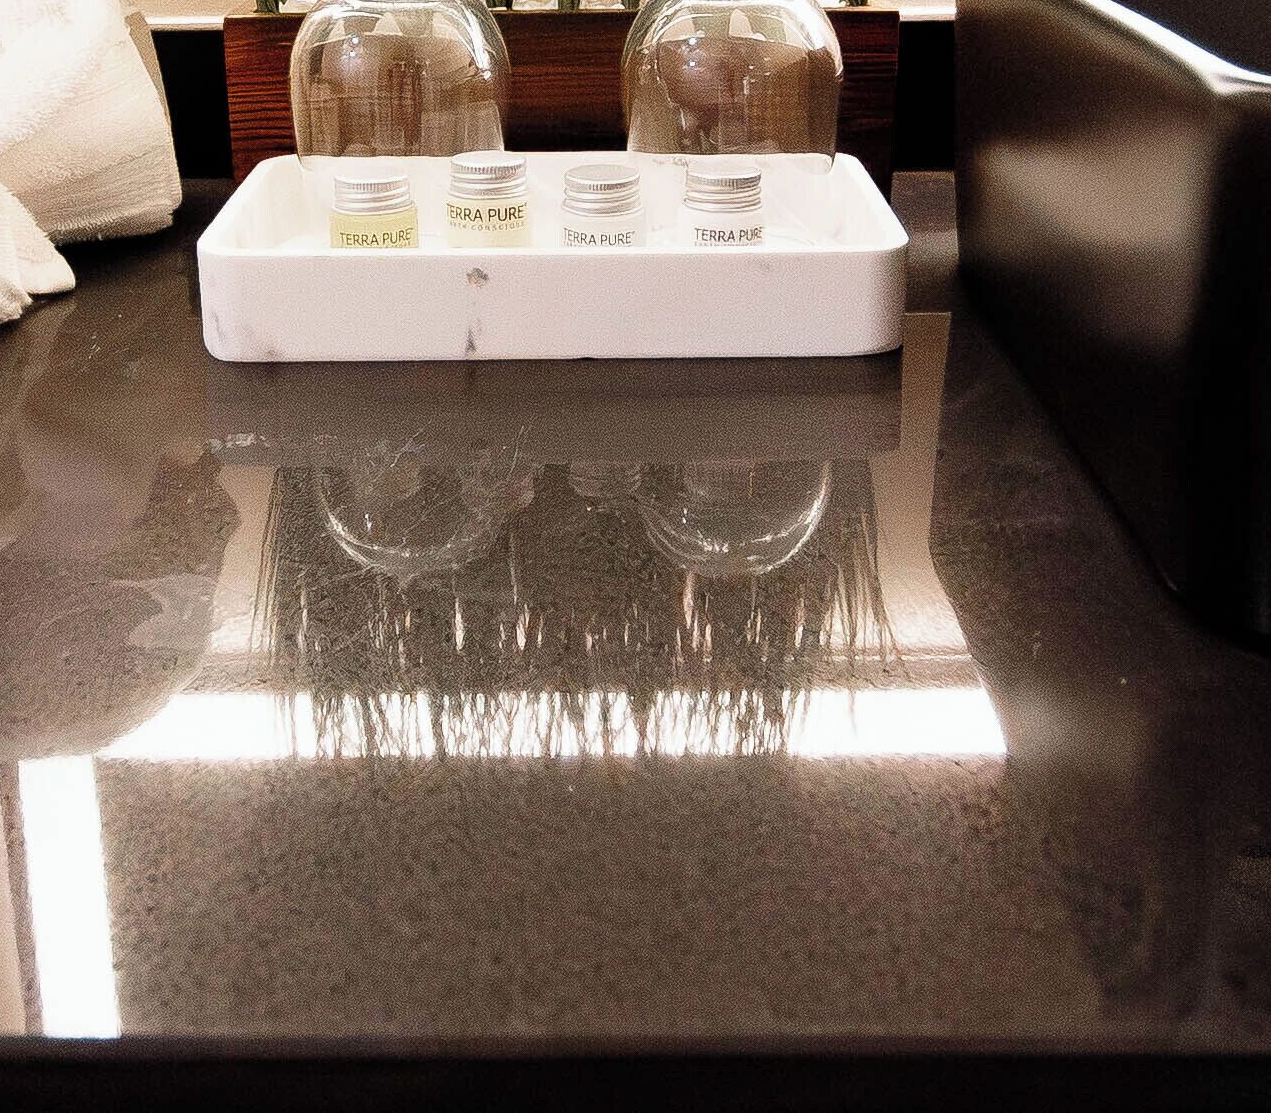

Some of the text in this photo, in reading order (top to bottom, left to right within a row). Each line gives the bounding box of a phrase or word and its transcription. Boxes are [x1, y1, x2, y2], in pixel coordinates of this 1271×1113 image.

[445, 202, 525, 223] TERRA PURE
[339, 231, 379, 246] TERRA
[382, 228, 412, 246] PURE
[563, 227, 597, 246] TERRA
[600, 231, 633, 246] PURE
[694, 227, 736, 243] TERRA
